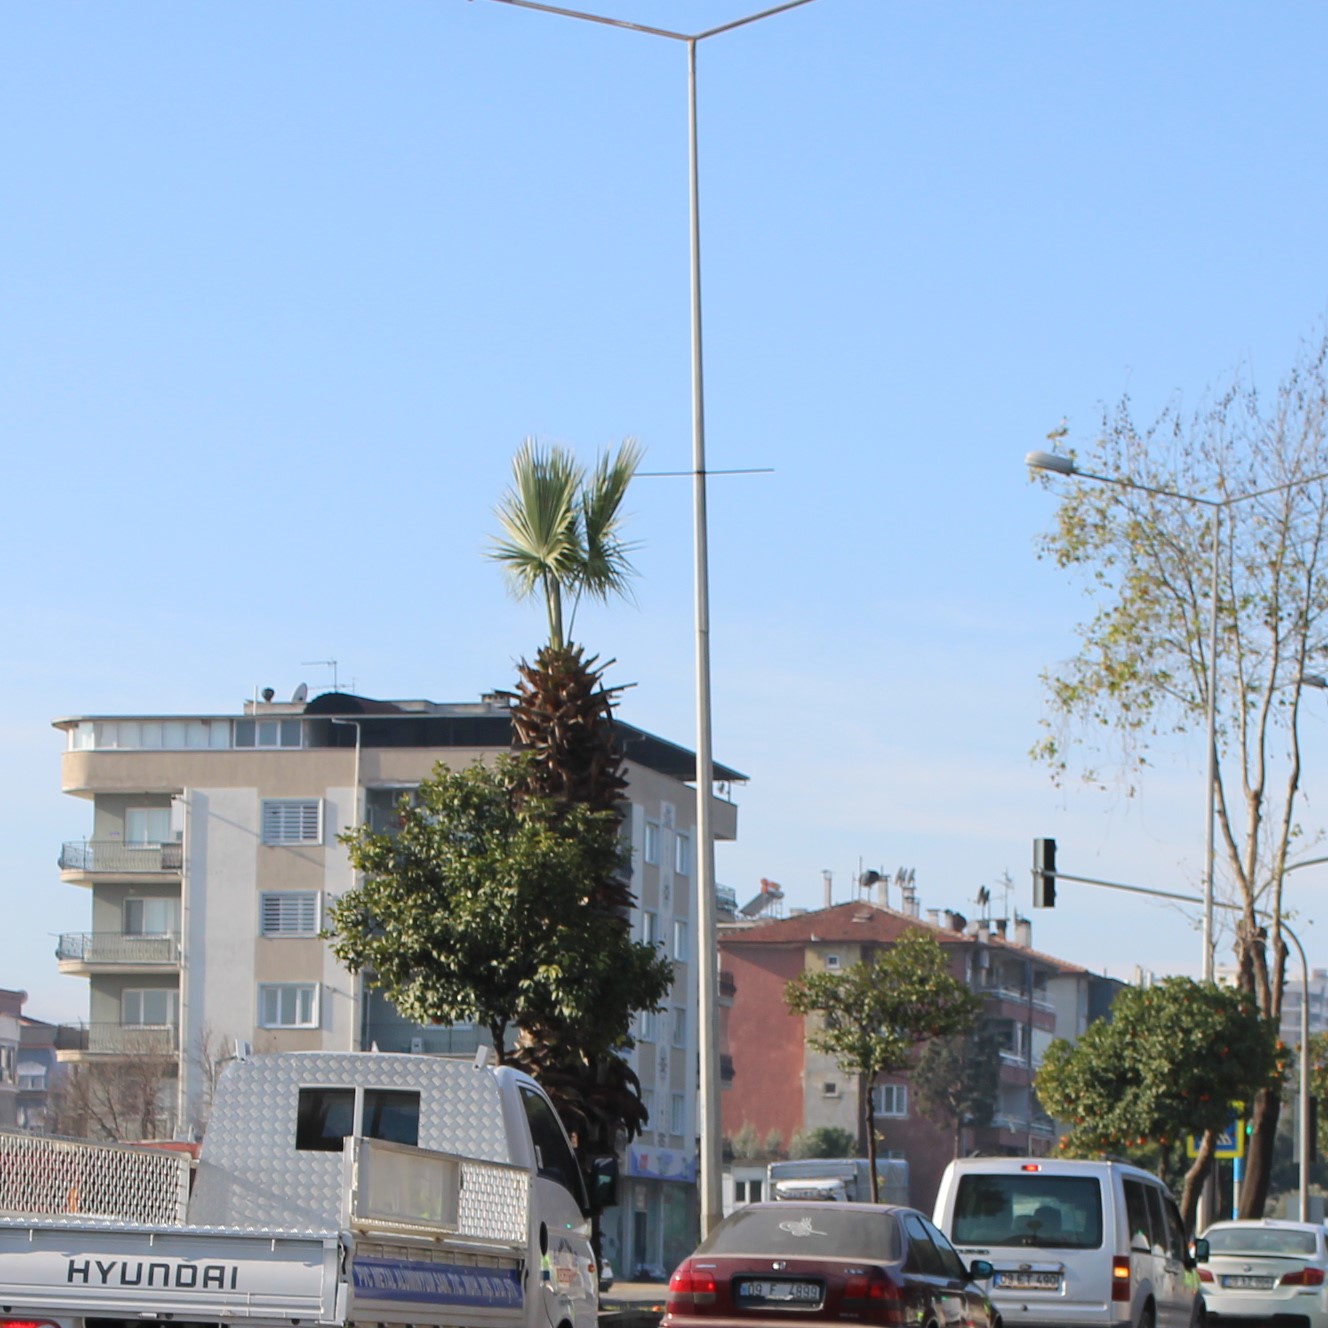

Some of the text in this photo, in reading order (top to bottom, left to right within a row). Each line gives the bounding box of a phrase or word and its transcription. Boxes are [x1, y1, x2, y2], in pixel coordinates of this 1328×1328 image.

[67, 1259, 238, 1290] HYUNDAI
[747, 1281, 763, 1296] 09
[788, 1284, 819, 1299] 4899
